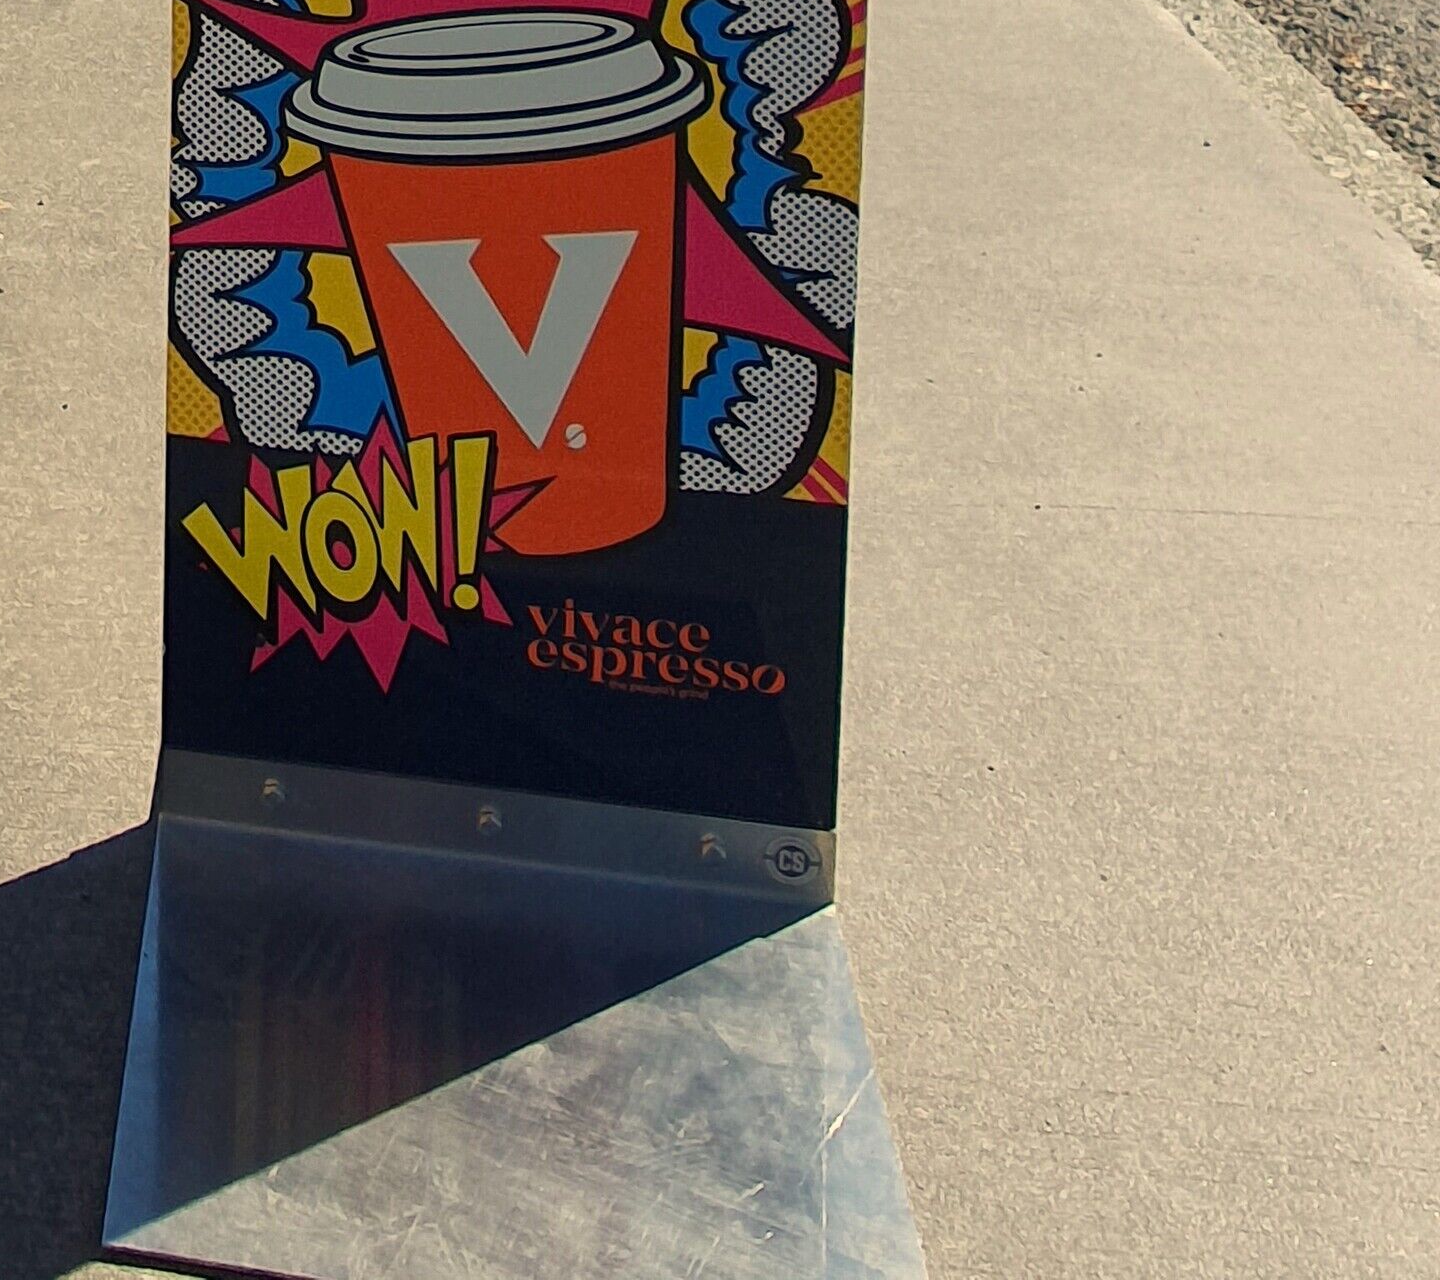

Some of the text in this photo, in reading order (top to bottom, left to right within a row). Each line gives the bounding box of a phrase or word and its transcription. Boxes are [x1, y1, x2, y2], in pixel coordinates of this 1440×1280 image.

[181, 436, 490, 621] WOW!
[527, 597, 710, 653] vivace
[526, 639, 786, 695] espresso
[779, 849, 806, 873] CS
